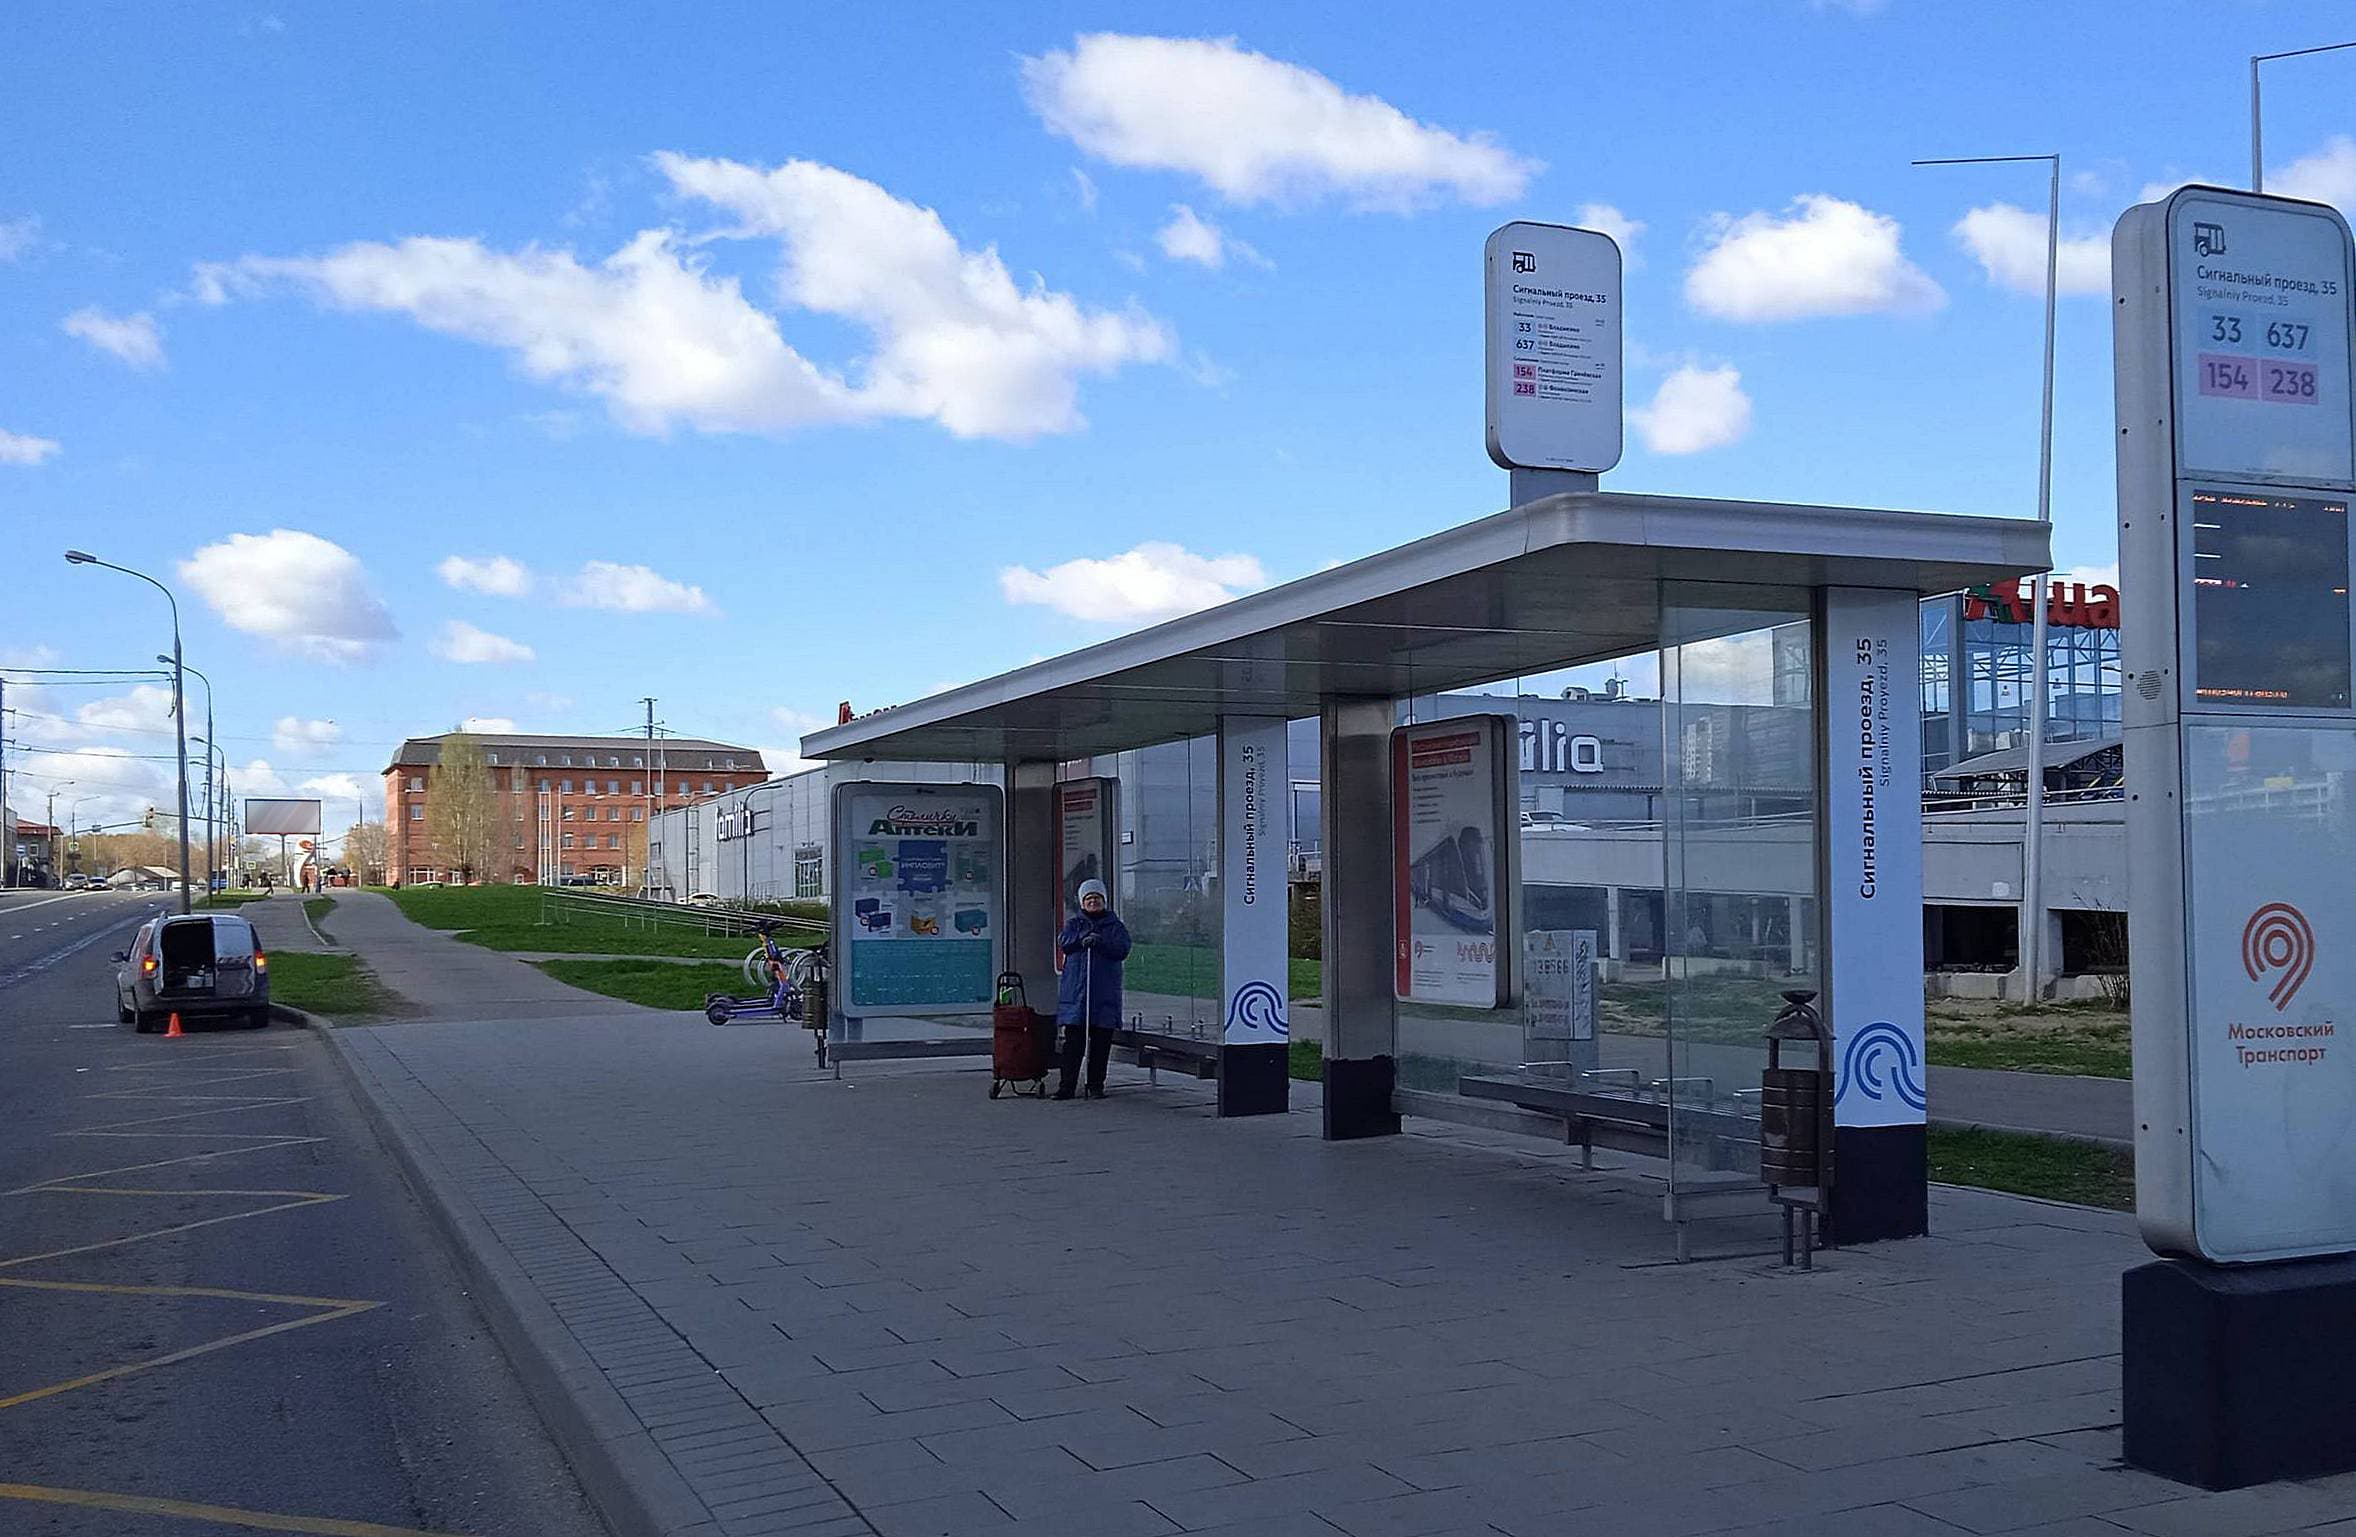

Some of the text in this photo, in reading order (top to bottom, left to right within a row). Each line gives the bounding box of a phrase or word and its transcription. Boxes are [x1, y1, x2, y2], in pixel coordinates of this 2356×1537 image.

[2197, 264, 2337, 296] Сигнальный проезд, 35
[1512, 284, 1607, 304] Сигнальный проезд, 35
[2278, 296, 2289, 306] 35
[1518, 322, 1532, 333] 33
[2212, 315, 2309, 350] 33 637
[1516, 339, 1535, 350] 637
[1516, 366, 1533, 377] 154
[2207, 361, 2315, 397] 154 238
[1516, 383, 1535, 394] 238
[1876, 638, 1892, 787] Signalniy Proyezd, 35
[1856, 637, 1876, 900] Сигнальный проезд, 35
[714, 800, 753, 842] familia
[1242, 745, 1257, 906] Сигнальный проезд, 35
[2228, 1020, 2334, 1041] Московский
[2235, 1045, 2328, 1069] Транспорт
